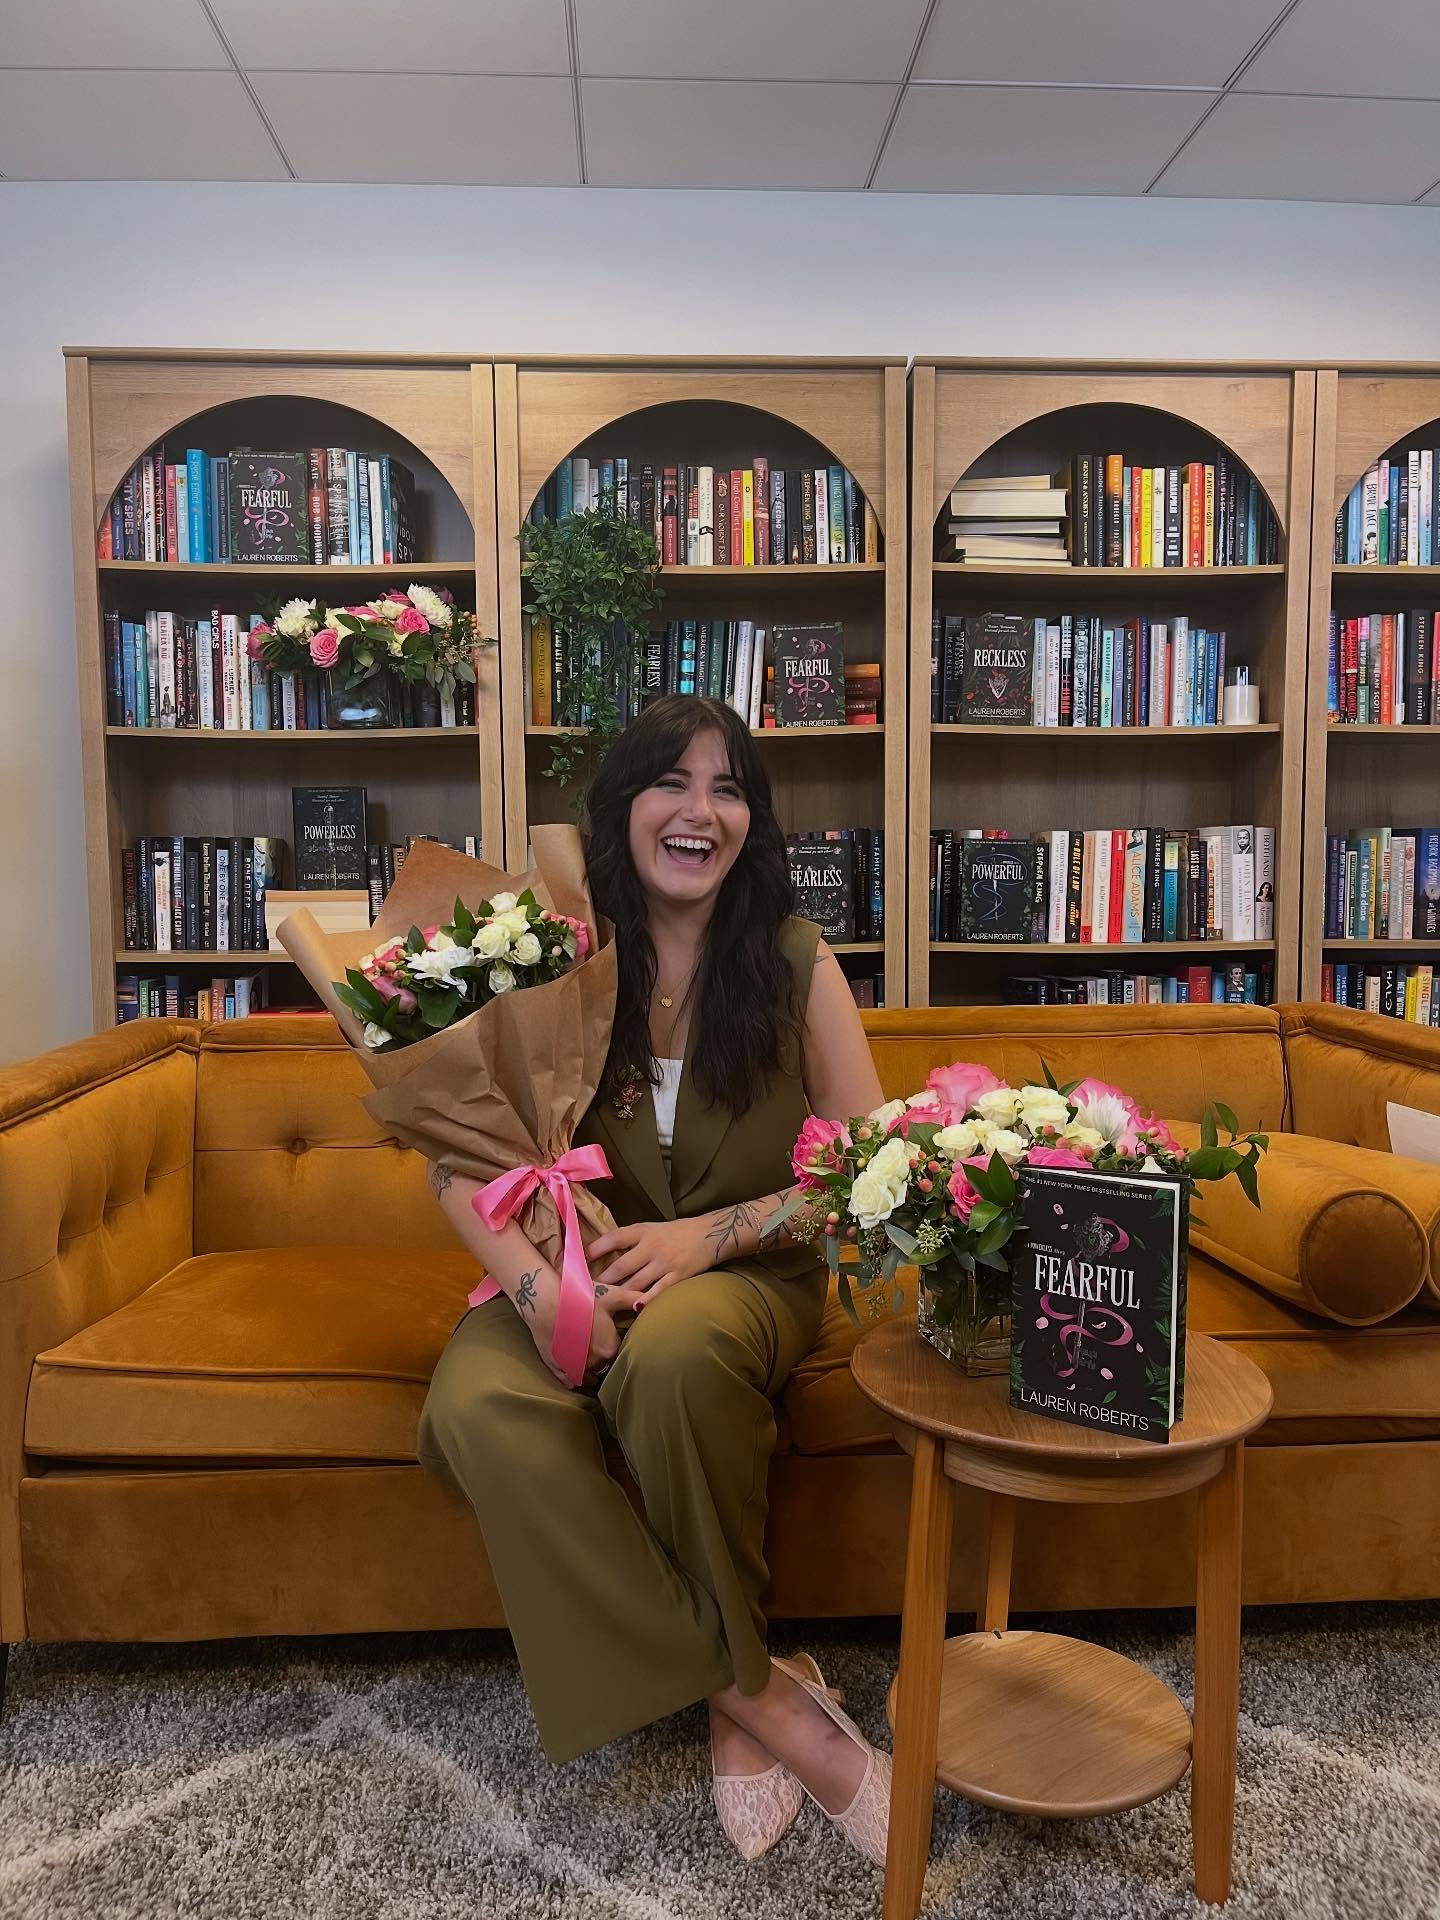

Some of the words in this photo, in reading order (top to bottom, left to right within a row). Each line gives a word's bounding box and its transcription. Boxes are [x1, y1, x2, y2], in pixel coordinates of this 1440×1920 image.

[310, 453, 319, 479] FEAR
[331, 453, 342, 481] BRUCE
[1410, 459, 1419, 490] IDIOT
[732, 477, 741, 494] High
[832, 476, 842, 499] THINGS
[1366, 483, 1377, 506] BRAVE
[241, 489, 292, 509] FEARFUL
[312, 496, 321, 514] BOB
[718, 503, 726, 518] OUR
[833, 500, 842, 513] YOU
[125, 505, 134, 534] SPIES
[156, 508, 164, 526] Out
[179, 509, 187, 534] down
[332, 483, 344, 539] SPRINGSTEEN
[733, 496, 741, 526] Conflict
[1366, 509, 1377, 528] FACE
[313, 516, 323, 564] WOODWARD
[718, 519, 726, 544] VIOLENT
[834, 533, 842, 545] SAY
[237, 553, 265, 562] LAUREN
[266, 554, 299, 563] ROBERTS
[159, 617, 168, 646] THEATER
[212, 626, 220, 649] GIRLS
[1078, 630, 1086, 652] BRAD
[160, 647, 169, 660] KID
[974, 649, 1027, 668] RECKLESS
[1078, 652, 1086, 675] THOR
[1417, 653, 1425, 674] KING
[647, 644, 661, 687] FEARLESS
[698, 660, 706, 683] MAGIC
[785, 658, 832, 678] FEARFUL
[1347, 673, 1357, 691] JOHN
[781, 720, 808, 728] LAUREN
[808, 719, 839, 727] ROBERTS
[969, 708, 996, 716] LAUREN
[996, 708, 1026, 716] ROBERTS
[303, 825, 356, 840] POWERLESS
[944, 832, 952, 855] TINA
[173, 841, 181, 854] THE
[1072, 847, 1081, 865] RULE
[1190, 850, 1200, 864] LAST
[1428, 834, 1439, 857] FREDRIK
[126, 852, 134, 875] RUTH
[173, 855, 181, 884] TERMINAL
[971, 863, 1024, 881] POWERFUL
[1036, 846, 1045, 880] STEPHEN
[1072, 865, 1081, 874] OF
[1131, 851, 1142, 880] ALICE
[1190, 864, 1200, 879] SEEN
[1427, 858, 1438, 885] BACKMAN
[126, 876, 134, 899] WARE
[219, 873, 226, 883] BY
[303, 872, 330, 881] LAUREN
[330, 872, 360, 881] ROBERTS
[790, 869, 843, 888] FEARLESS
[944, 857, 952, 896] TURNER
[1071, 875, 1081, 892] LAW
[1361, 871, 1370, 899] whale
[174, 886, 182, 899] LIST
[1034, 881, 1043, 904] KING
[1130, 882, 1142, 918] ADAMS
[174, 905, 182, 919] JACK
[1360, 899, 1369, 921] done
[1426, 908, 1437, 933] WINNERS
[966, 932, 993, 941] LAUREN
[993, 933, 1024, 941] ROBERTS
[1356, 971, 1364, 990] What
[1385, 970, 1393, 1011] HALO
[1421, 976, 1431, 1011] SINGLE
[1025, 1176, 1036, 1184] THE
[1043, 1179, 1057, 1187] NEW
[1057, 1181, 1073, 1189] YORK
[1073, 1184, 1091, 1192] TIMES
[1091, 1186, 1130, 1198] BESTSELLING
[1130, 1191, 1153, 1201] SERIES
[1034, 1253, 1141, 1310] FEARFUL
[1020, 1387, 1076, 1415] LAUREN
[1079, 1402, 1149, 1431] ROBERTS
